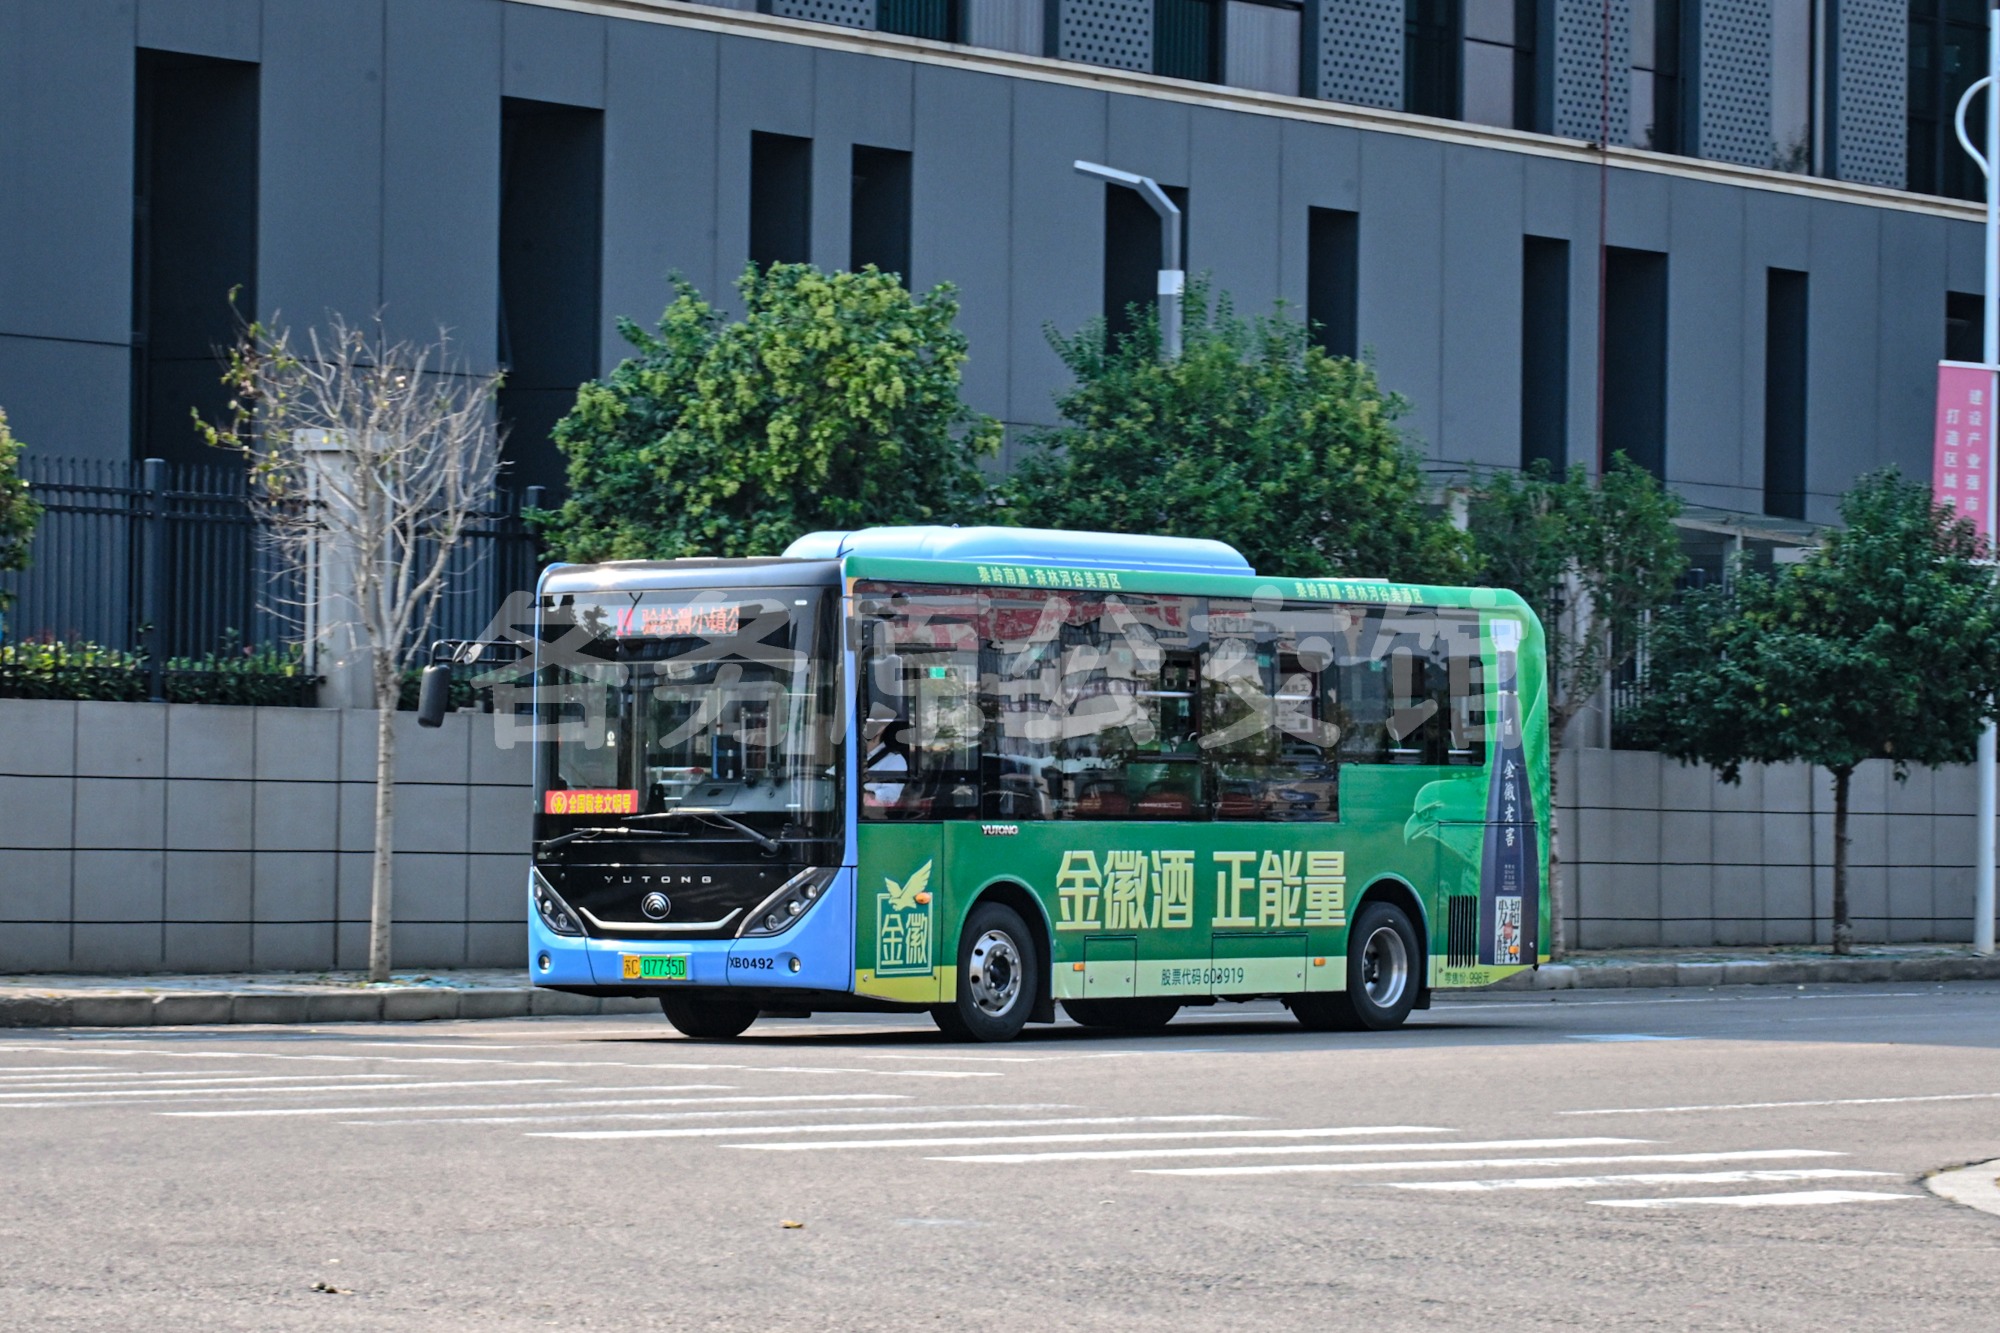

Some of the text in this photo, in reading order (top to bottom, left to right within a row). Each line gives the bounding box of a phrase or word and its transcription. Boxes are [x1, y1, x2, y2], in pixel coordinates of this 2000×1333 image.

[1941, 408, 1960, 531] 打造区域中
[569, 794, 632, 814] 全国敬老文明号
[982, 824, 1019, 836] YUTONG
[604, 875, 712, 884] YUTONG
[1055, 849, 1347, 931] 金徽酒 正能量
[881, 913, 928, 966] 金徽
[729, 957, 775, 970] XB0492
[1161, 967, 1245, 987] 股票代码 603919
